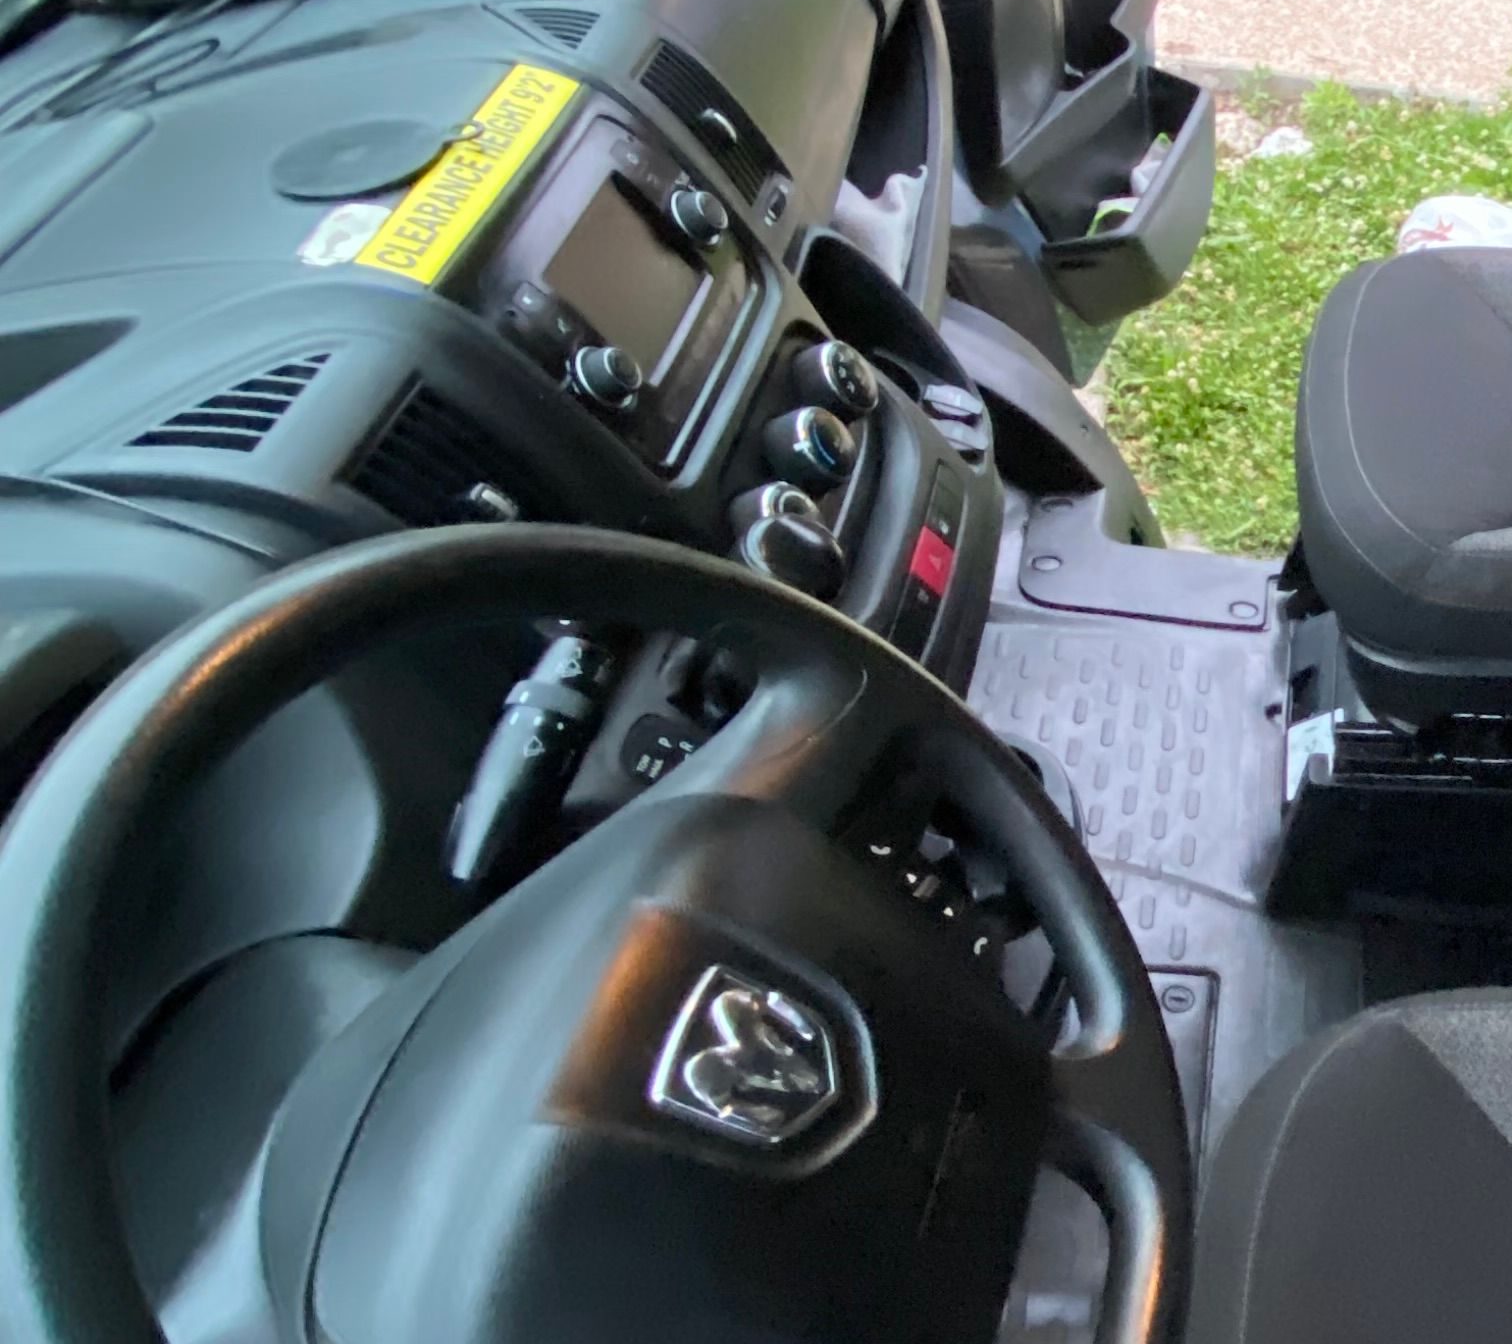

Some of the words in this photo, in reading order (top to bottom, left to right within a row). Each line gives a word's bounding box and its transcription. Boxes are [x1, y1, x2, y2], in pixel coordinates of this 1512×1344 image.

[376, 155, 492, 268] CLEARANCE
[466, 99, 536, 160] HEIGHT
[658, 737, 672, 748] P
[679, 741, 694, 752] R
